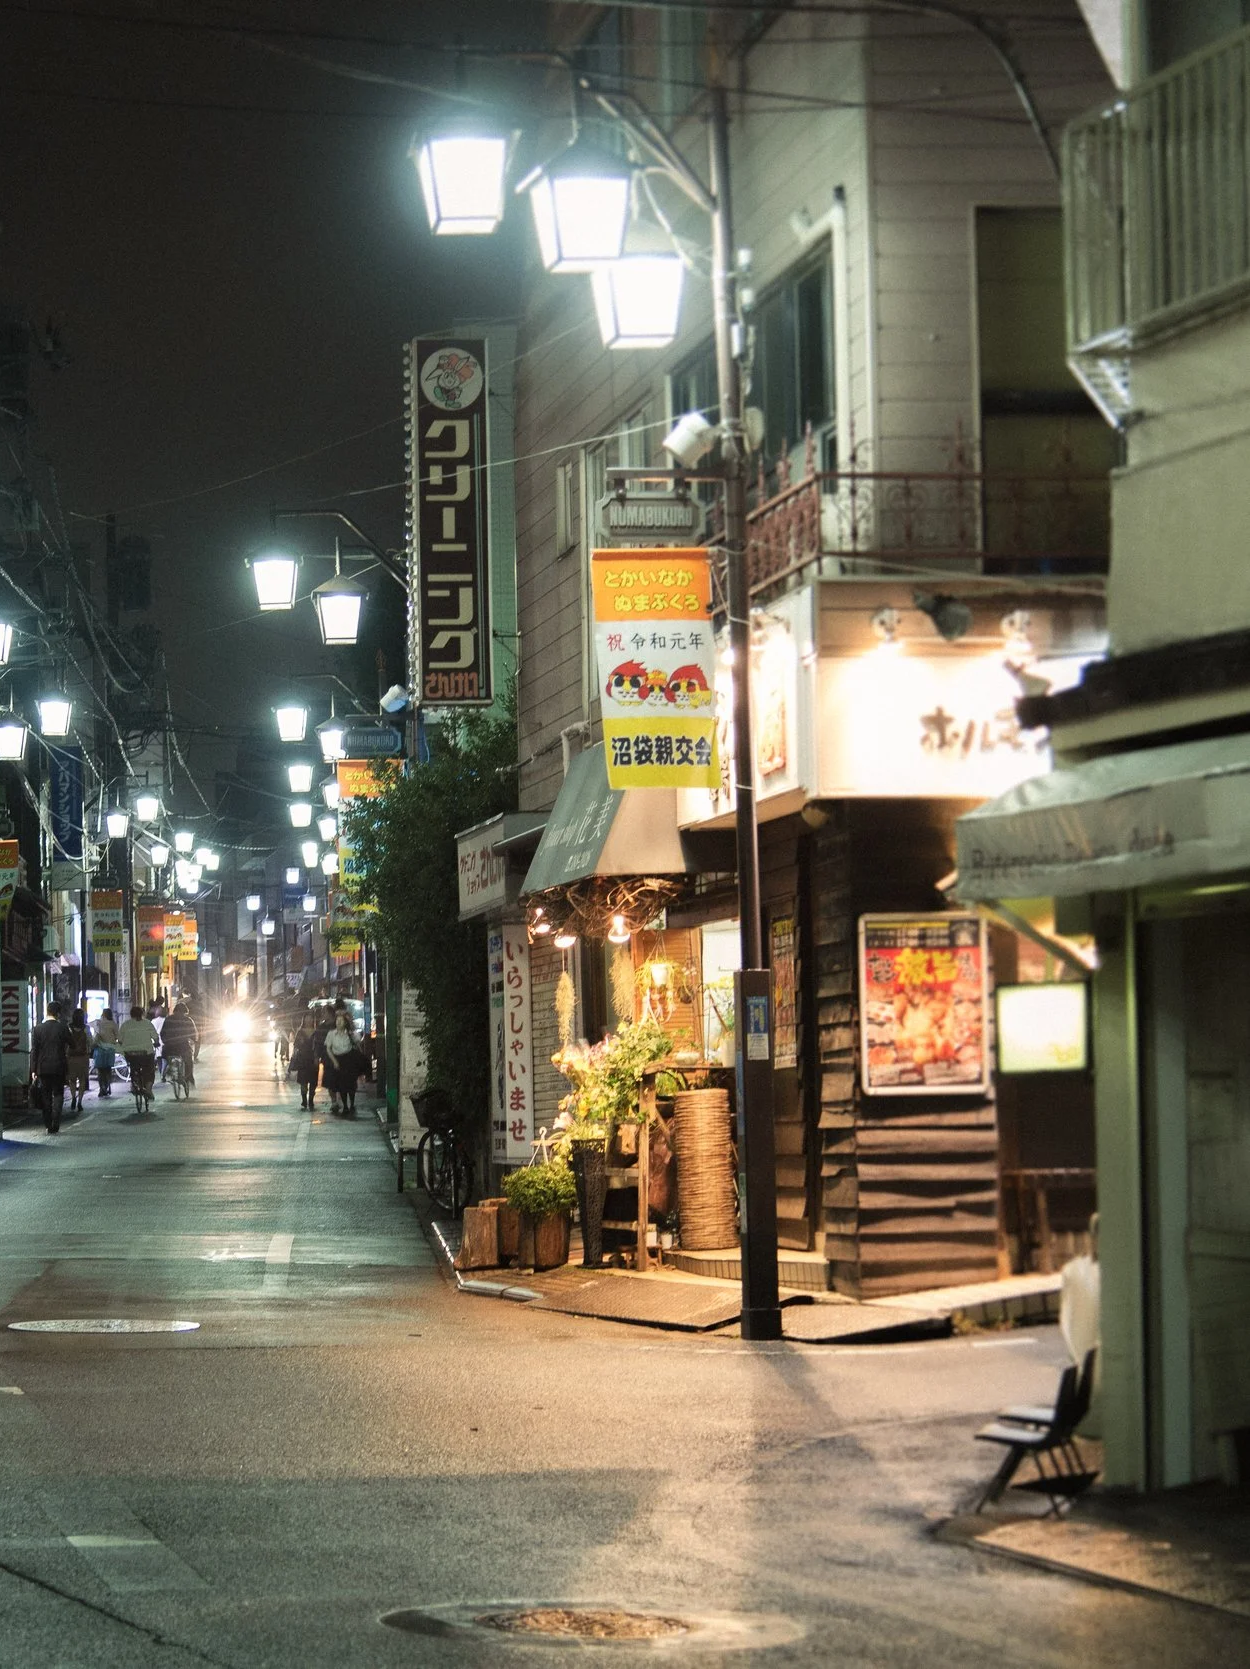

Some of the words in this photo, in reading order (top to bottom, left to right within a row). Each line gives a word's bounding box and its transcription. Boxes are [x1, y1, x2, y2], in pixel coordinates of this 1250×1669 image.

[609, 506, 693, 528] NUMABUKURO
[425, 419, 477, 669] クリーニング
[604, 570, 693, 588] とかいなか
[614, 593, 700, 612] ぬまぶくろ
[607, 633, 625, 651] 祝
[631, 632, 704, 651] 令和元年
[425, 672, 478, 698] さんけい
[920, 706, 1048, 759] ホルモ
[612, 735, 712, 767] 沼袋親交会
[2, 986, 19, 1054] KIRIN
[506, 941, 527, 1142] いらっしゃいませ
